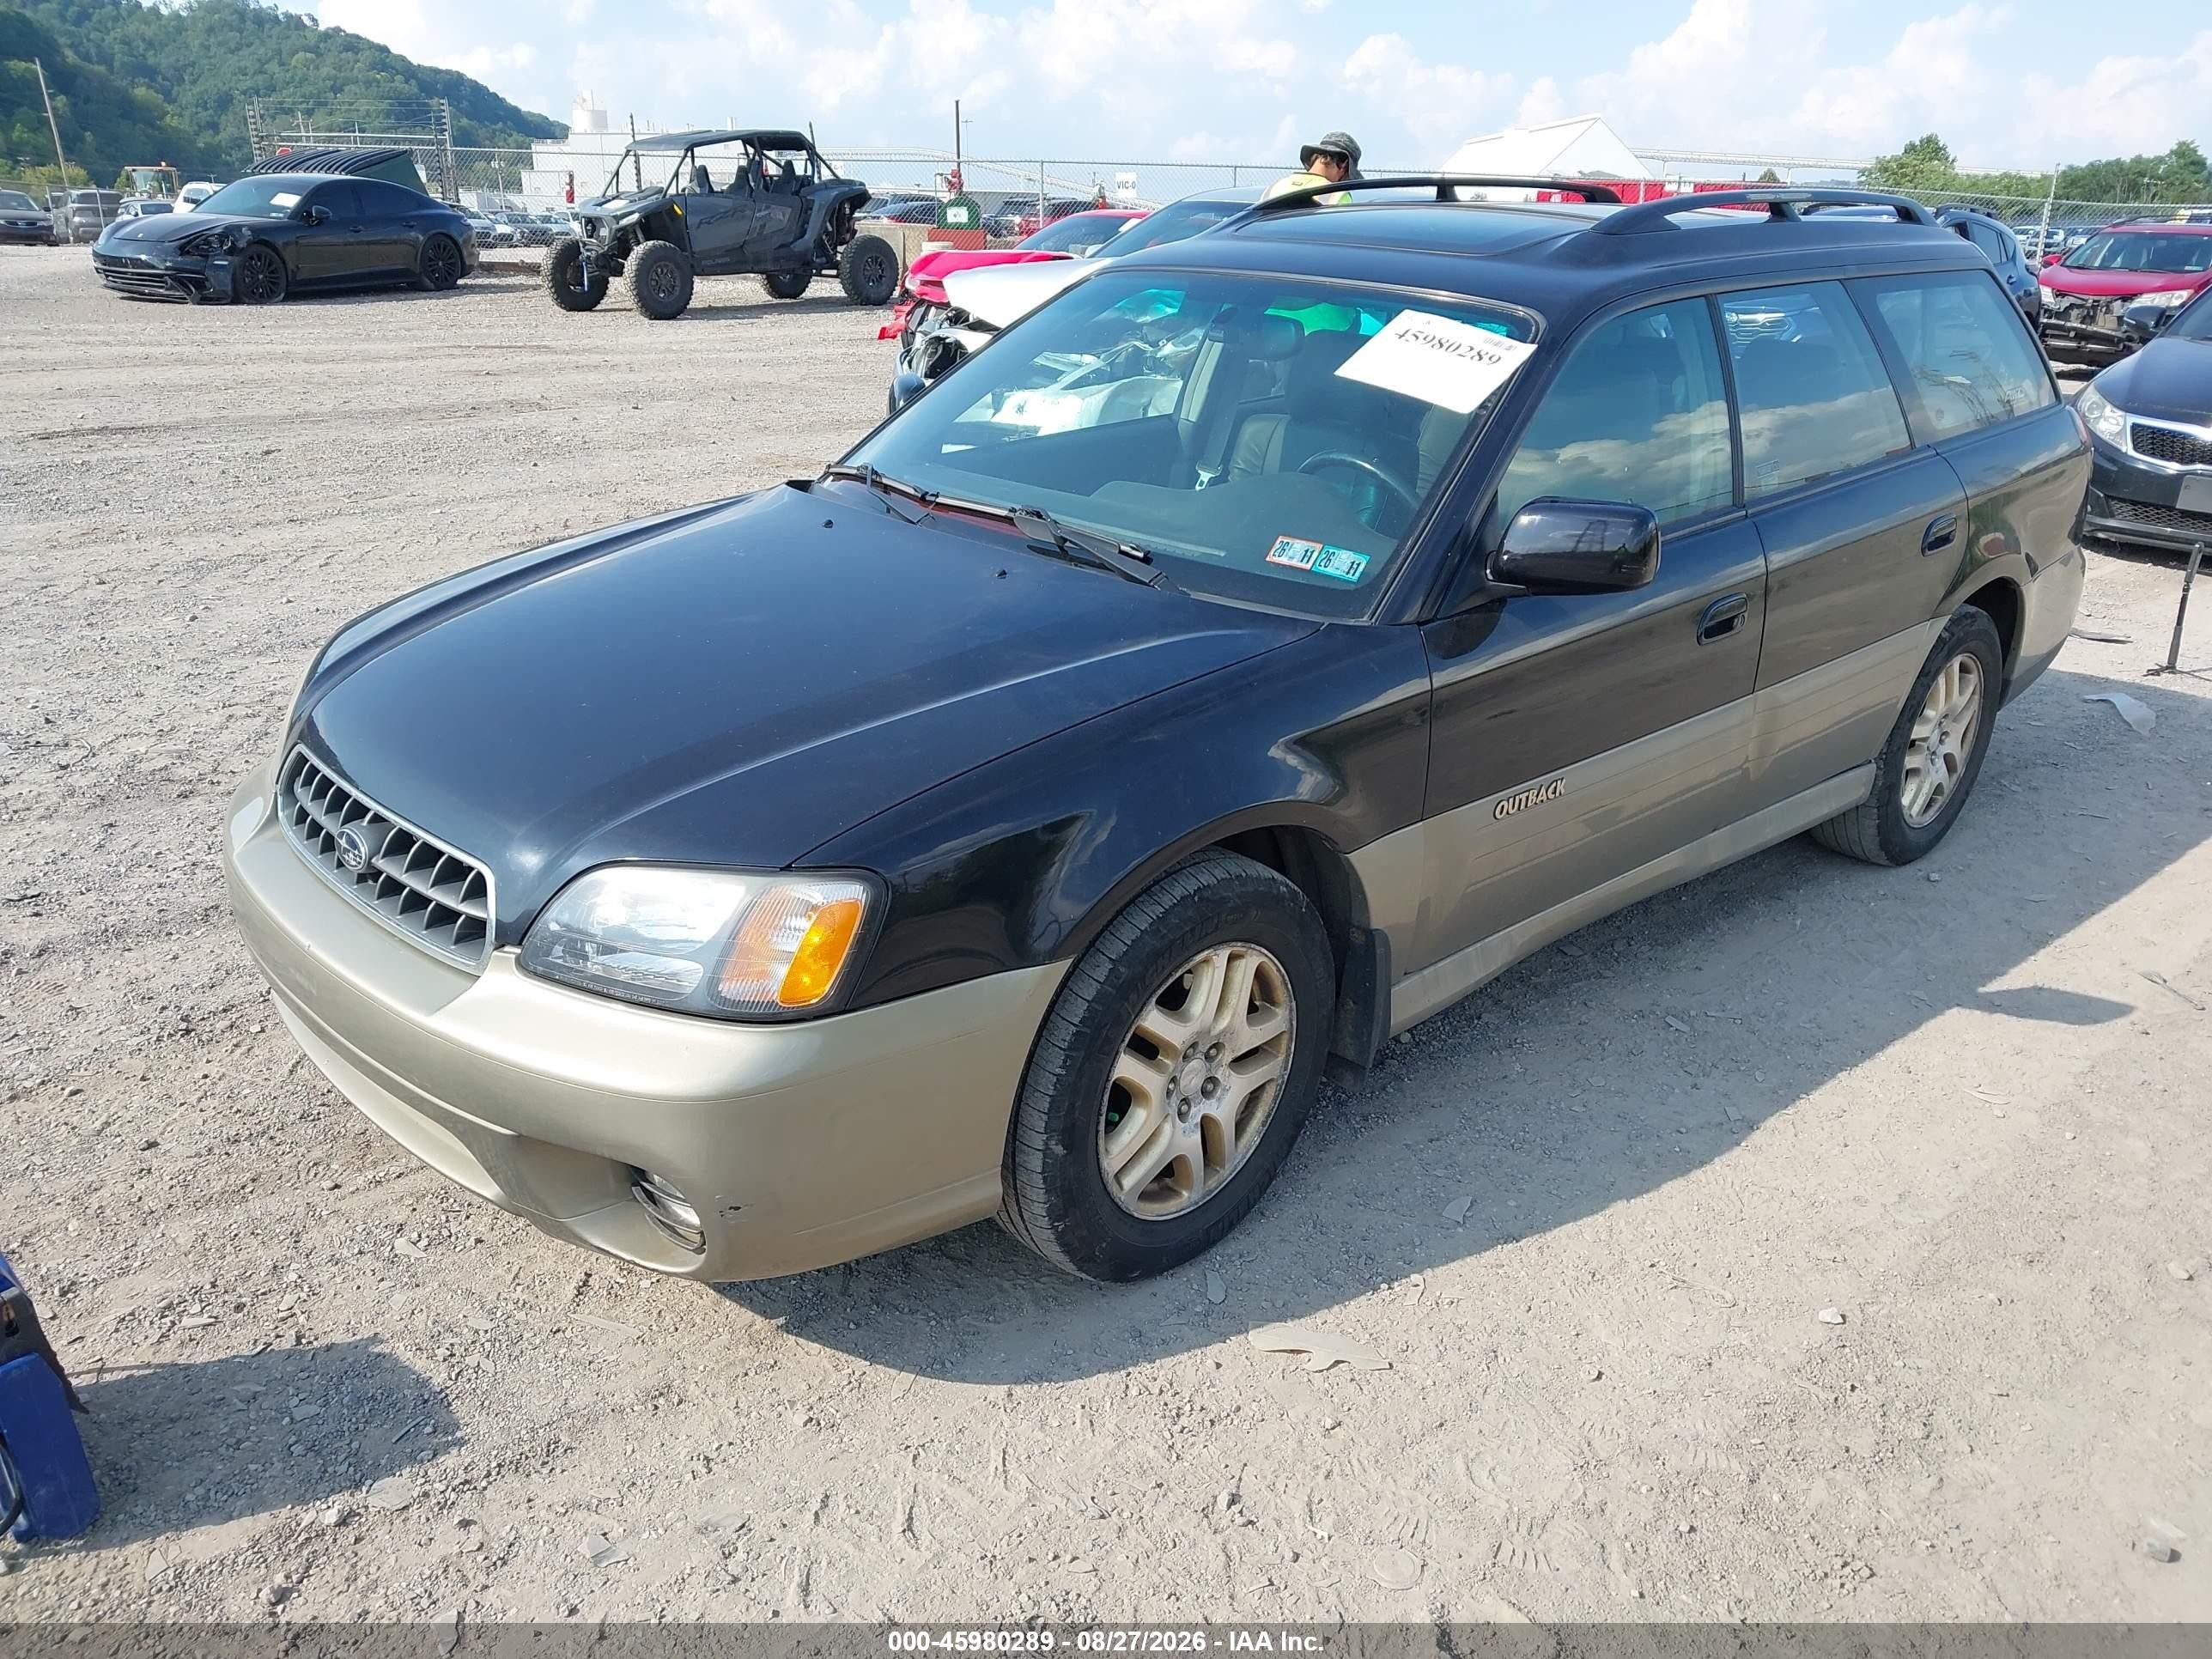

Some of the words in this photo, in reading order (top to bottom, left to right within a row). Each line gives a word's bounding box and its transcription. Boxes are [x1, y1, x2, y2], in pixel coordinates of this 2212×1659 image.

[1395, 328, 1502, 365] 45980289
[1300, 548, 1315, 564] 11
[1346, 560, 1362, 577] 11
[1493, 777, 1566, 820] OUTBACK
